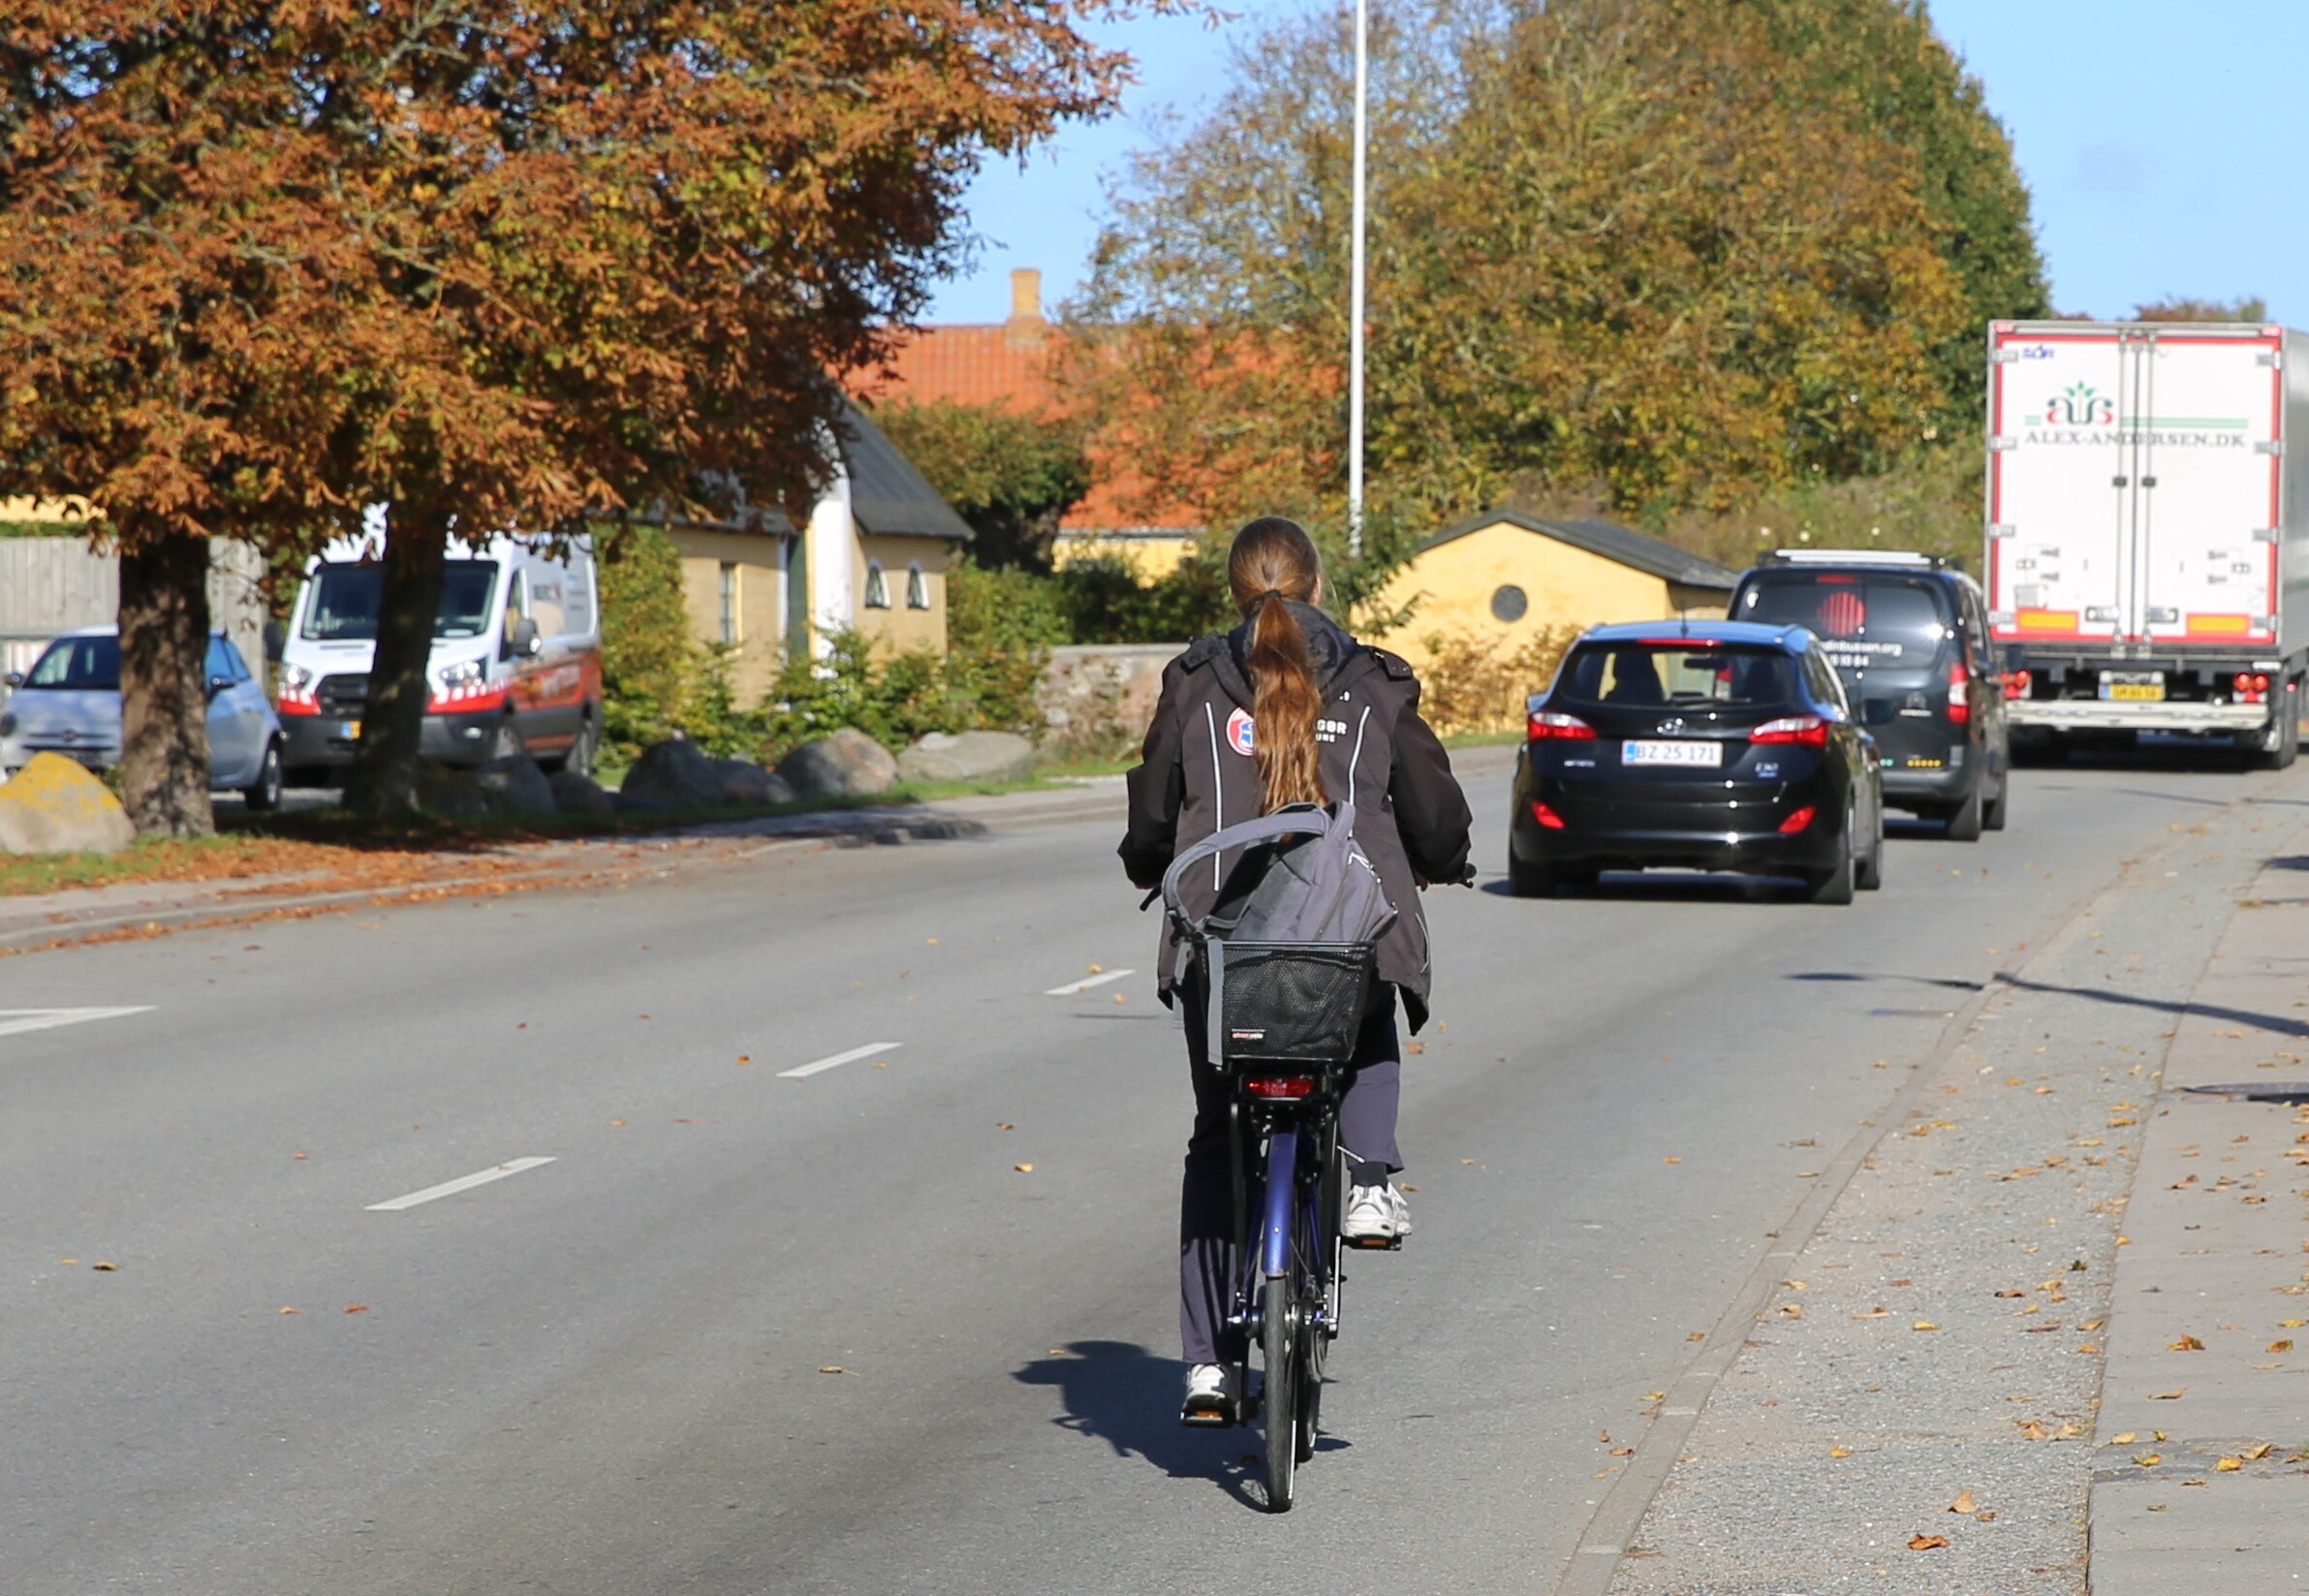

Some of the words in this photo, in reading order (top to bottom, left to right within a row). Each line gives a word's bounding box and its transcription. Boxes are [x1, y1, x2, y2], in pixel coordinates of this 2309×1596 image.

[1315, 733, 1335, 743] UNE
[1663, 745, 1682, 761] 25
[1689, 746, 1714, 762] 171
